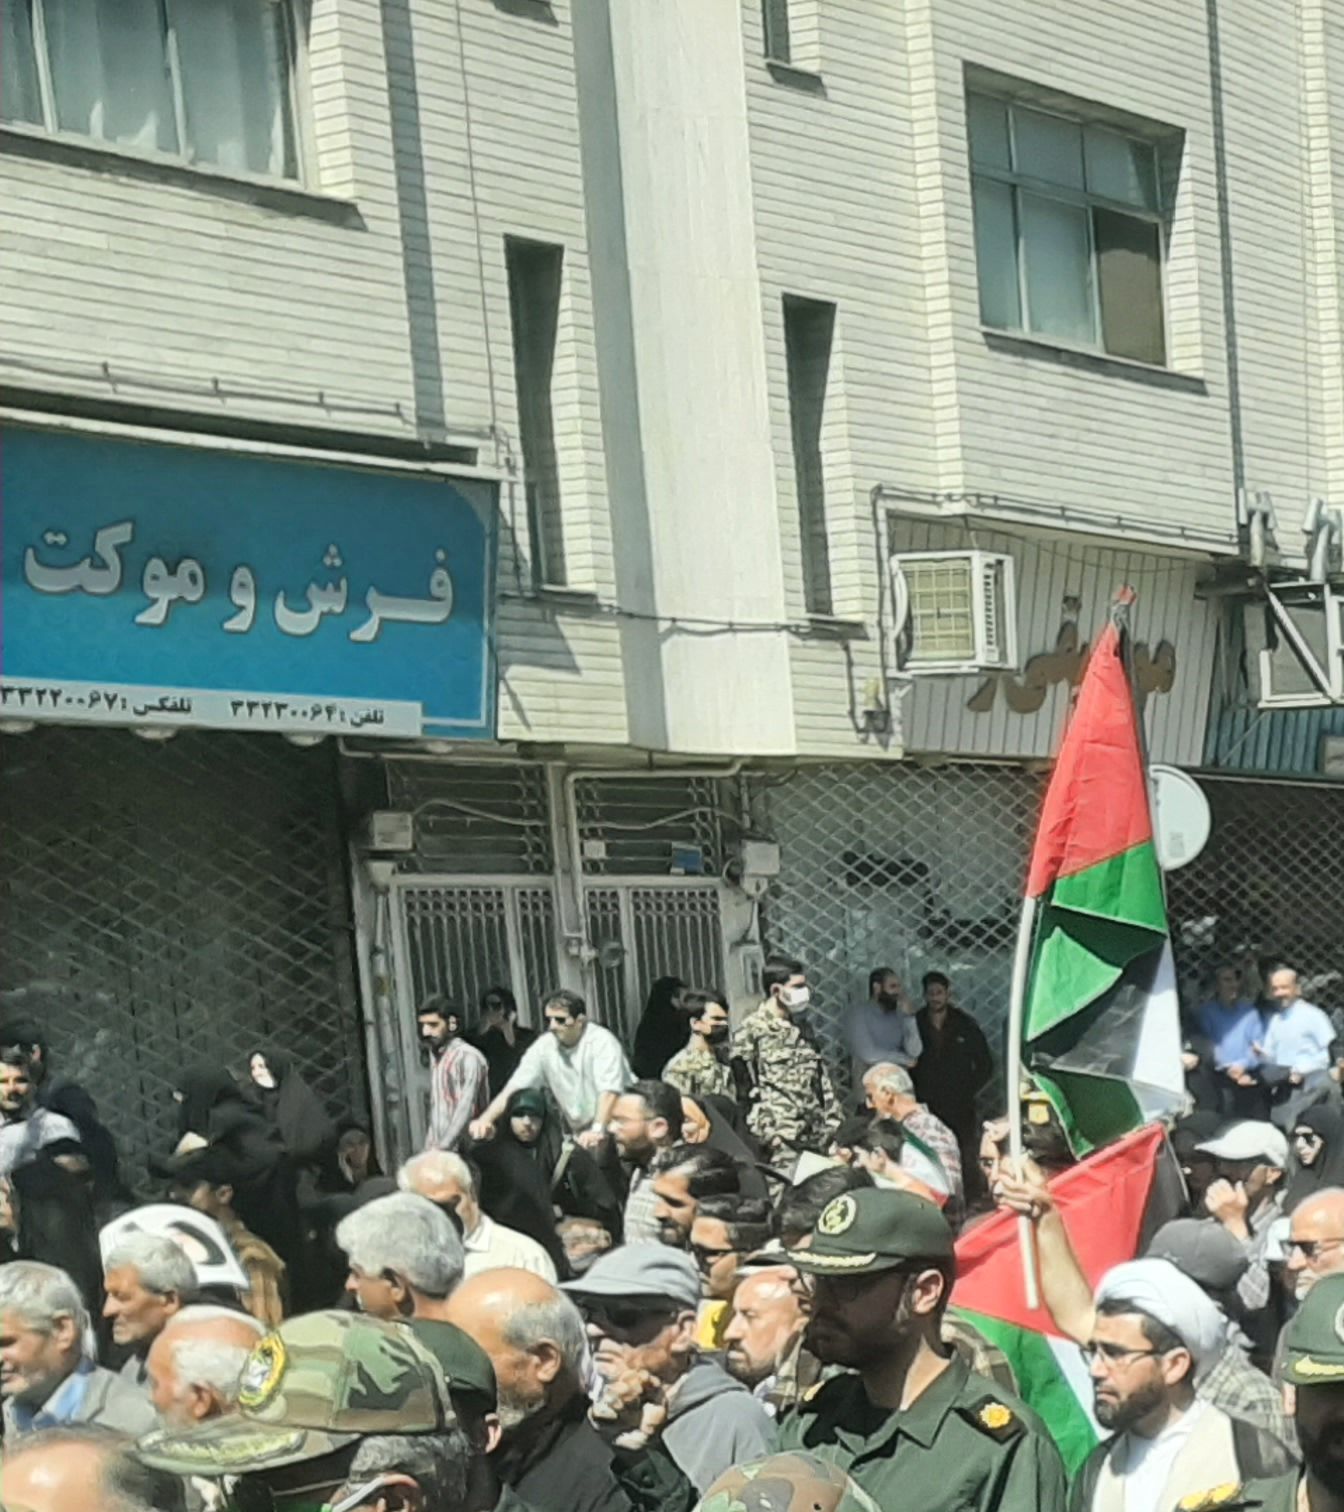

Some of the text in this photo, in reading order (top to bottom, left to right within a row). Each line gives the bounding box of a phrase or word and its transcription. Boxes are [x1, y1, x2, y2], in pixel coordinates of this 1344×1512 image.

[23, 520, 456, 643] فرش و موکت
